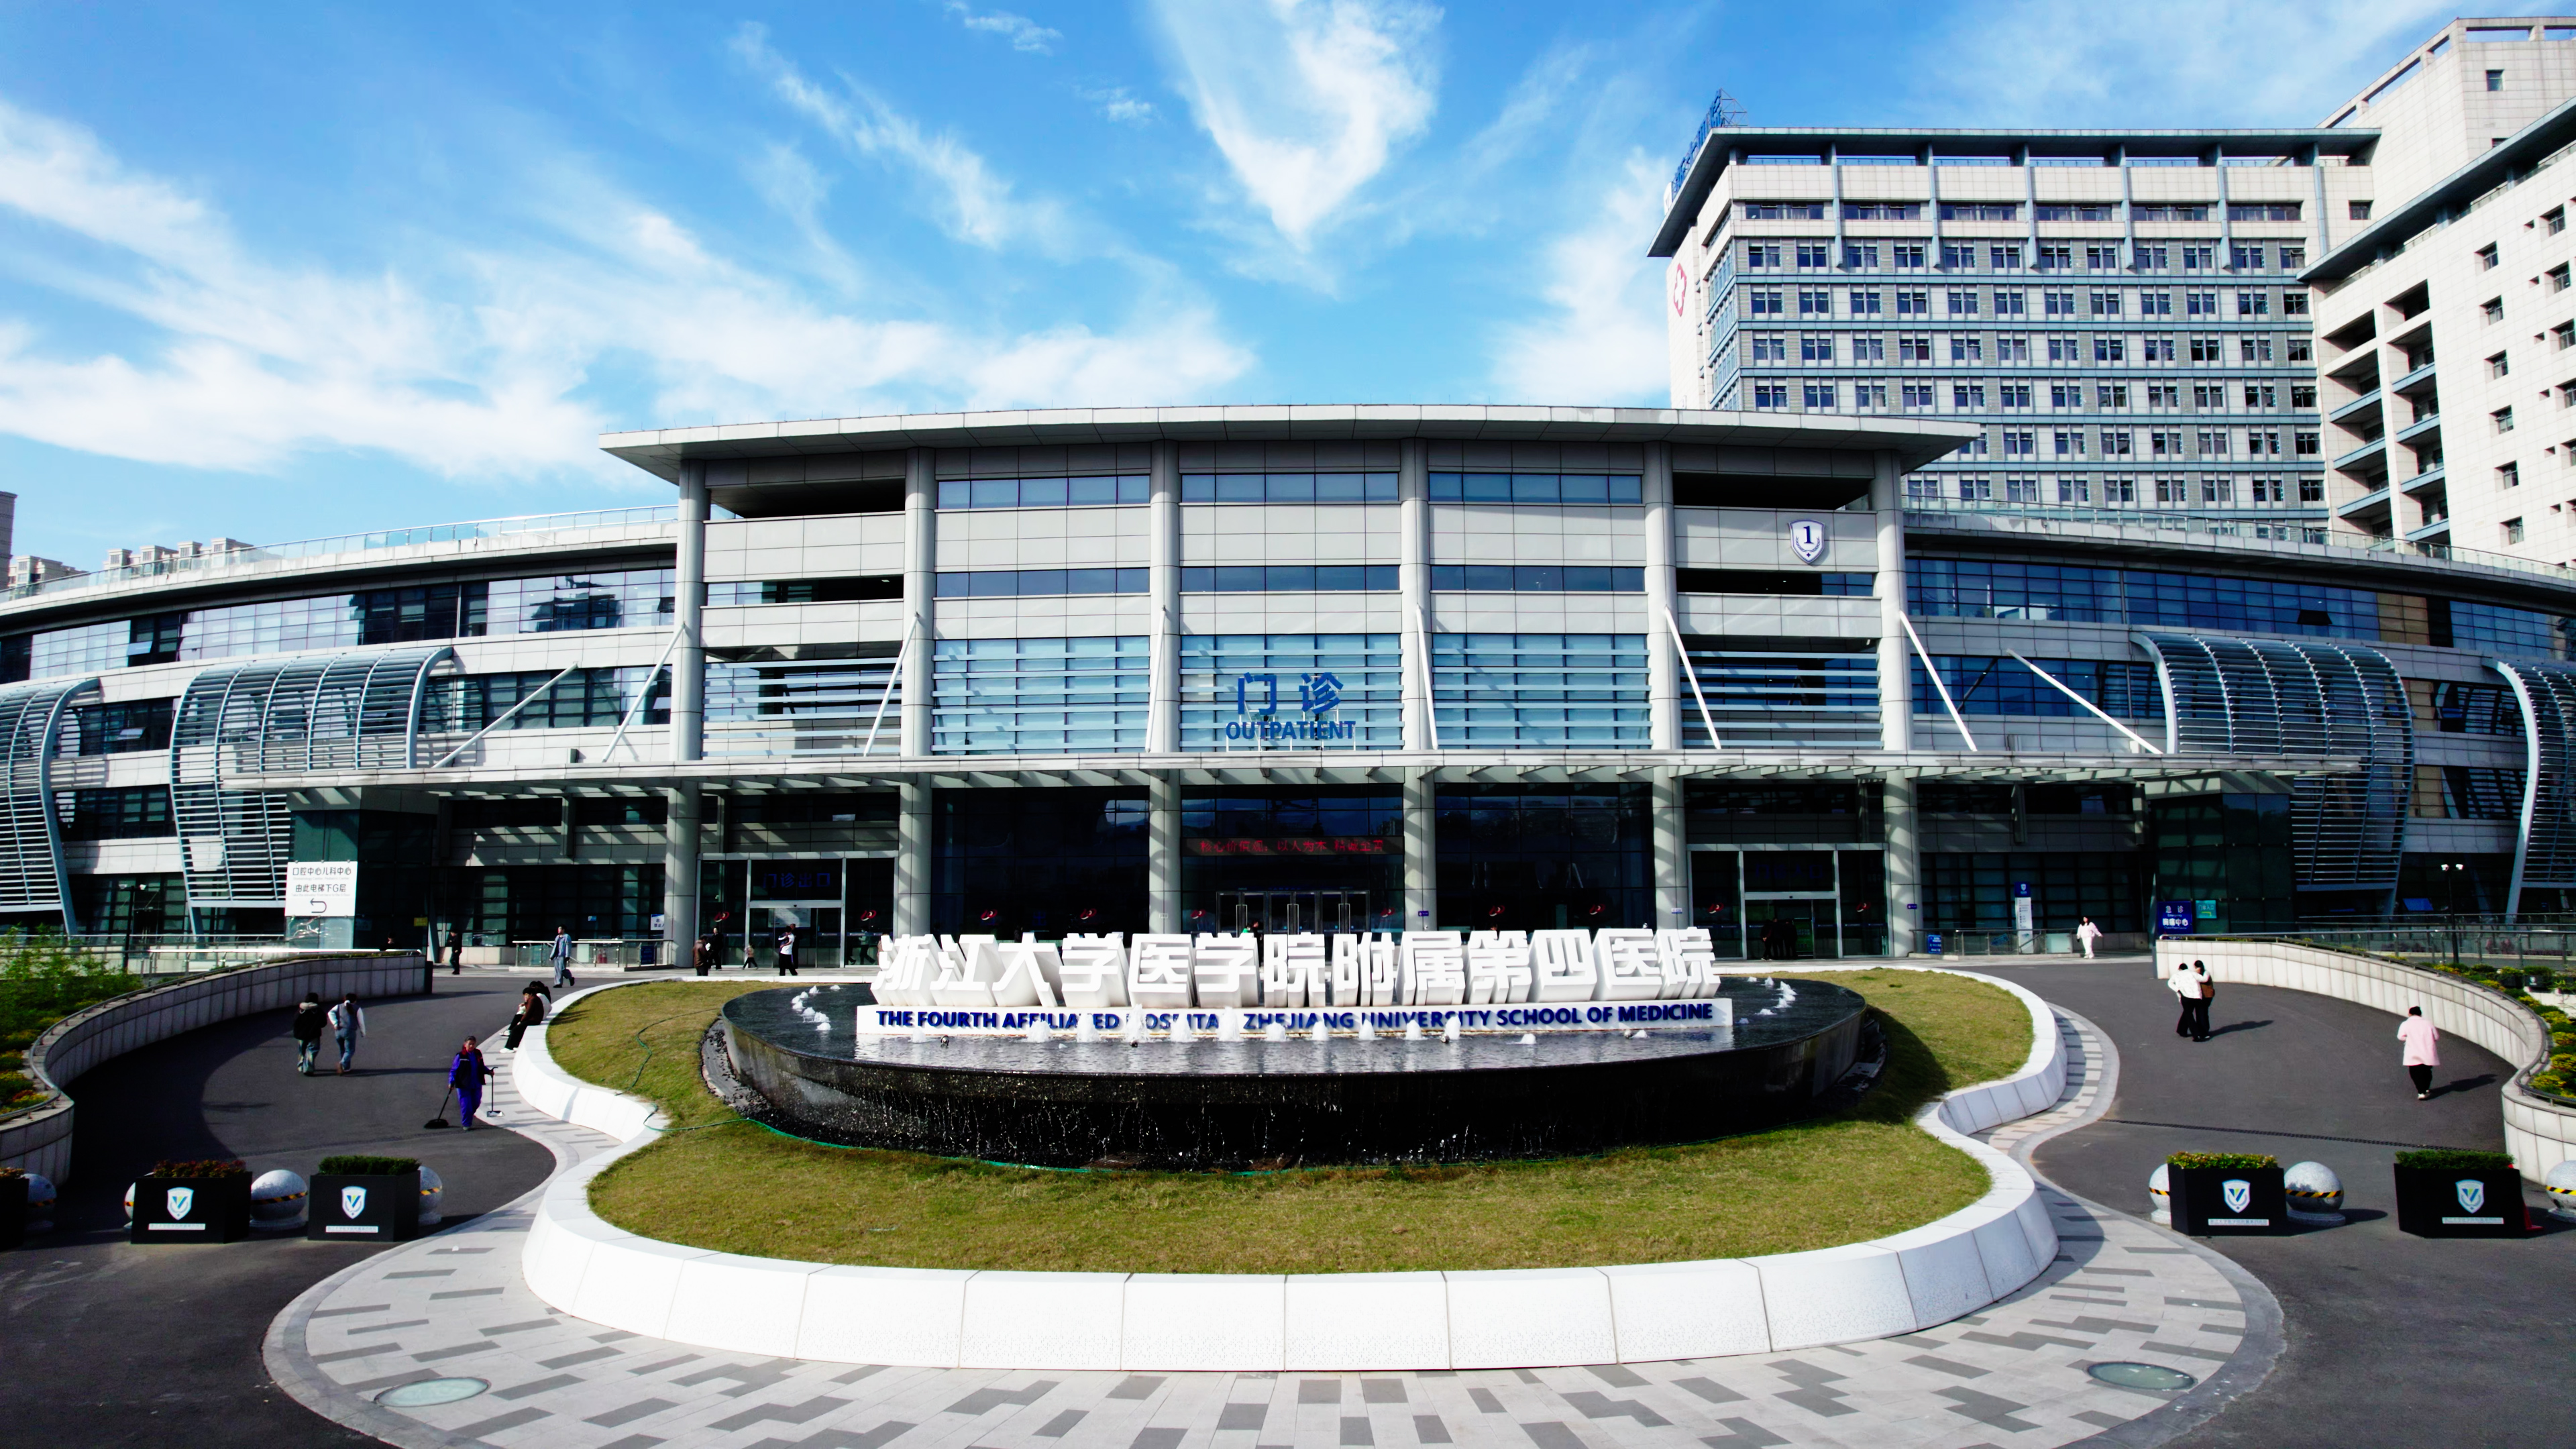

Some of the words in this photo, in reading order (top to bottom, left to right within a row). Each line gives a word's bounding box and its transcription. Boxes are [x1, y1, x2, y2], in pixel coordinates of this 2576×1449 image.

[1803, 525, 1814, 545] 1
[1237, 672, 1344, 716] 门诊
[1226, 720, 1356, 740] OUTPATIENT
[292, 867, 352, 875] 口腔中心儿科中心
[762, 872, 831, 889] 门诊出口
[295, 883, 347, 893] 由此电梯下G层
[870, 927, 1721, 1005] 浙江大学医学院附属第四医院
[876, 1010, 912, 1026] THE
[918, 1012, 997, 1028] FOURTH
[1002, 1013, 1120, 1029] AFFILIAED
[1497, 1008, 1582, 1026] SCHOOL
[1587, 1007, 1613, 1023] OF
[1618, 1004, 1713, 1022] MEDICINE
